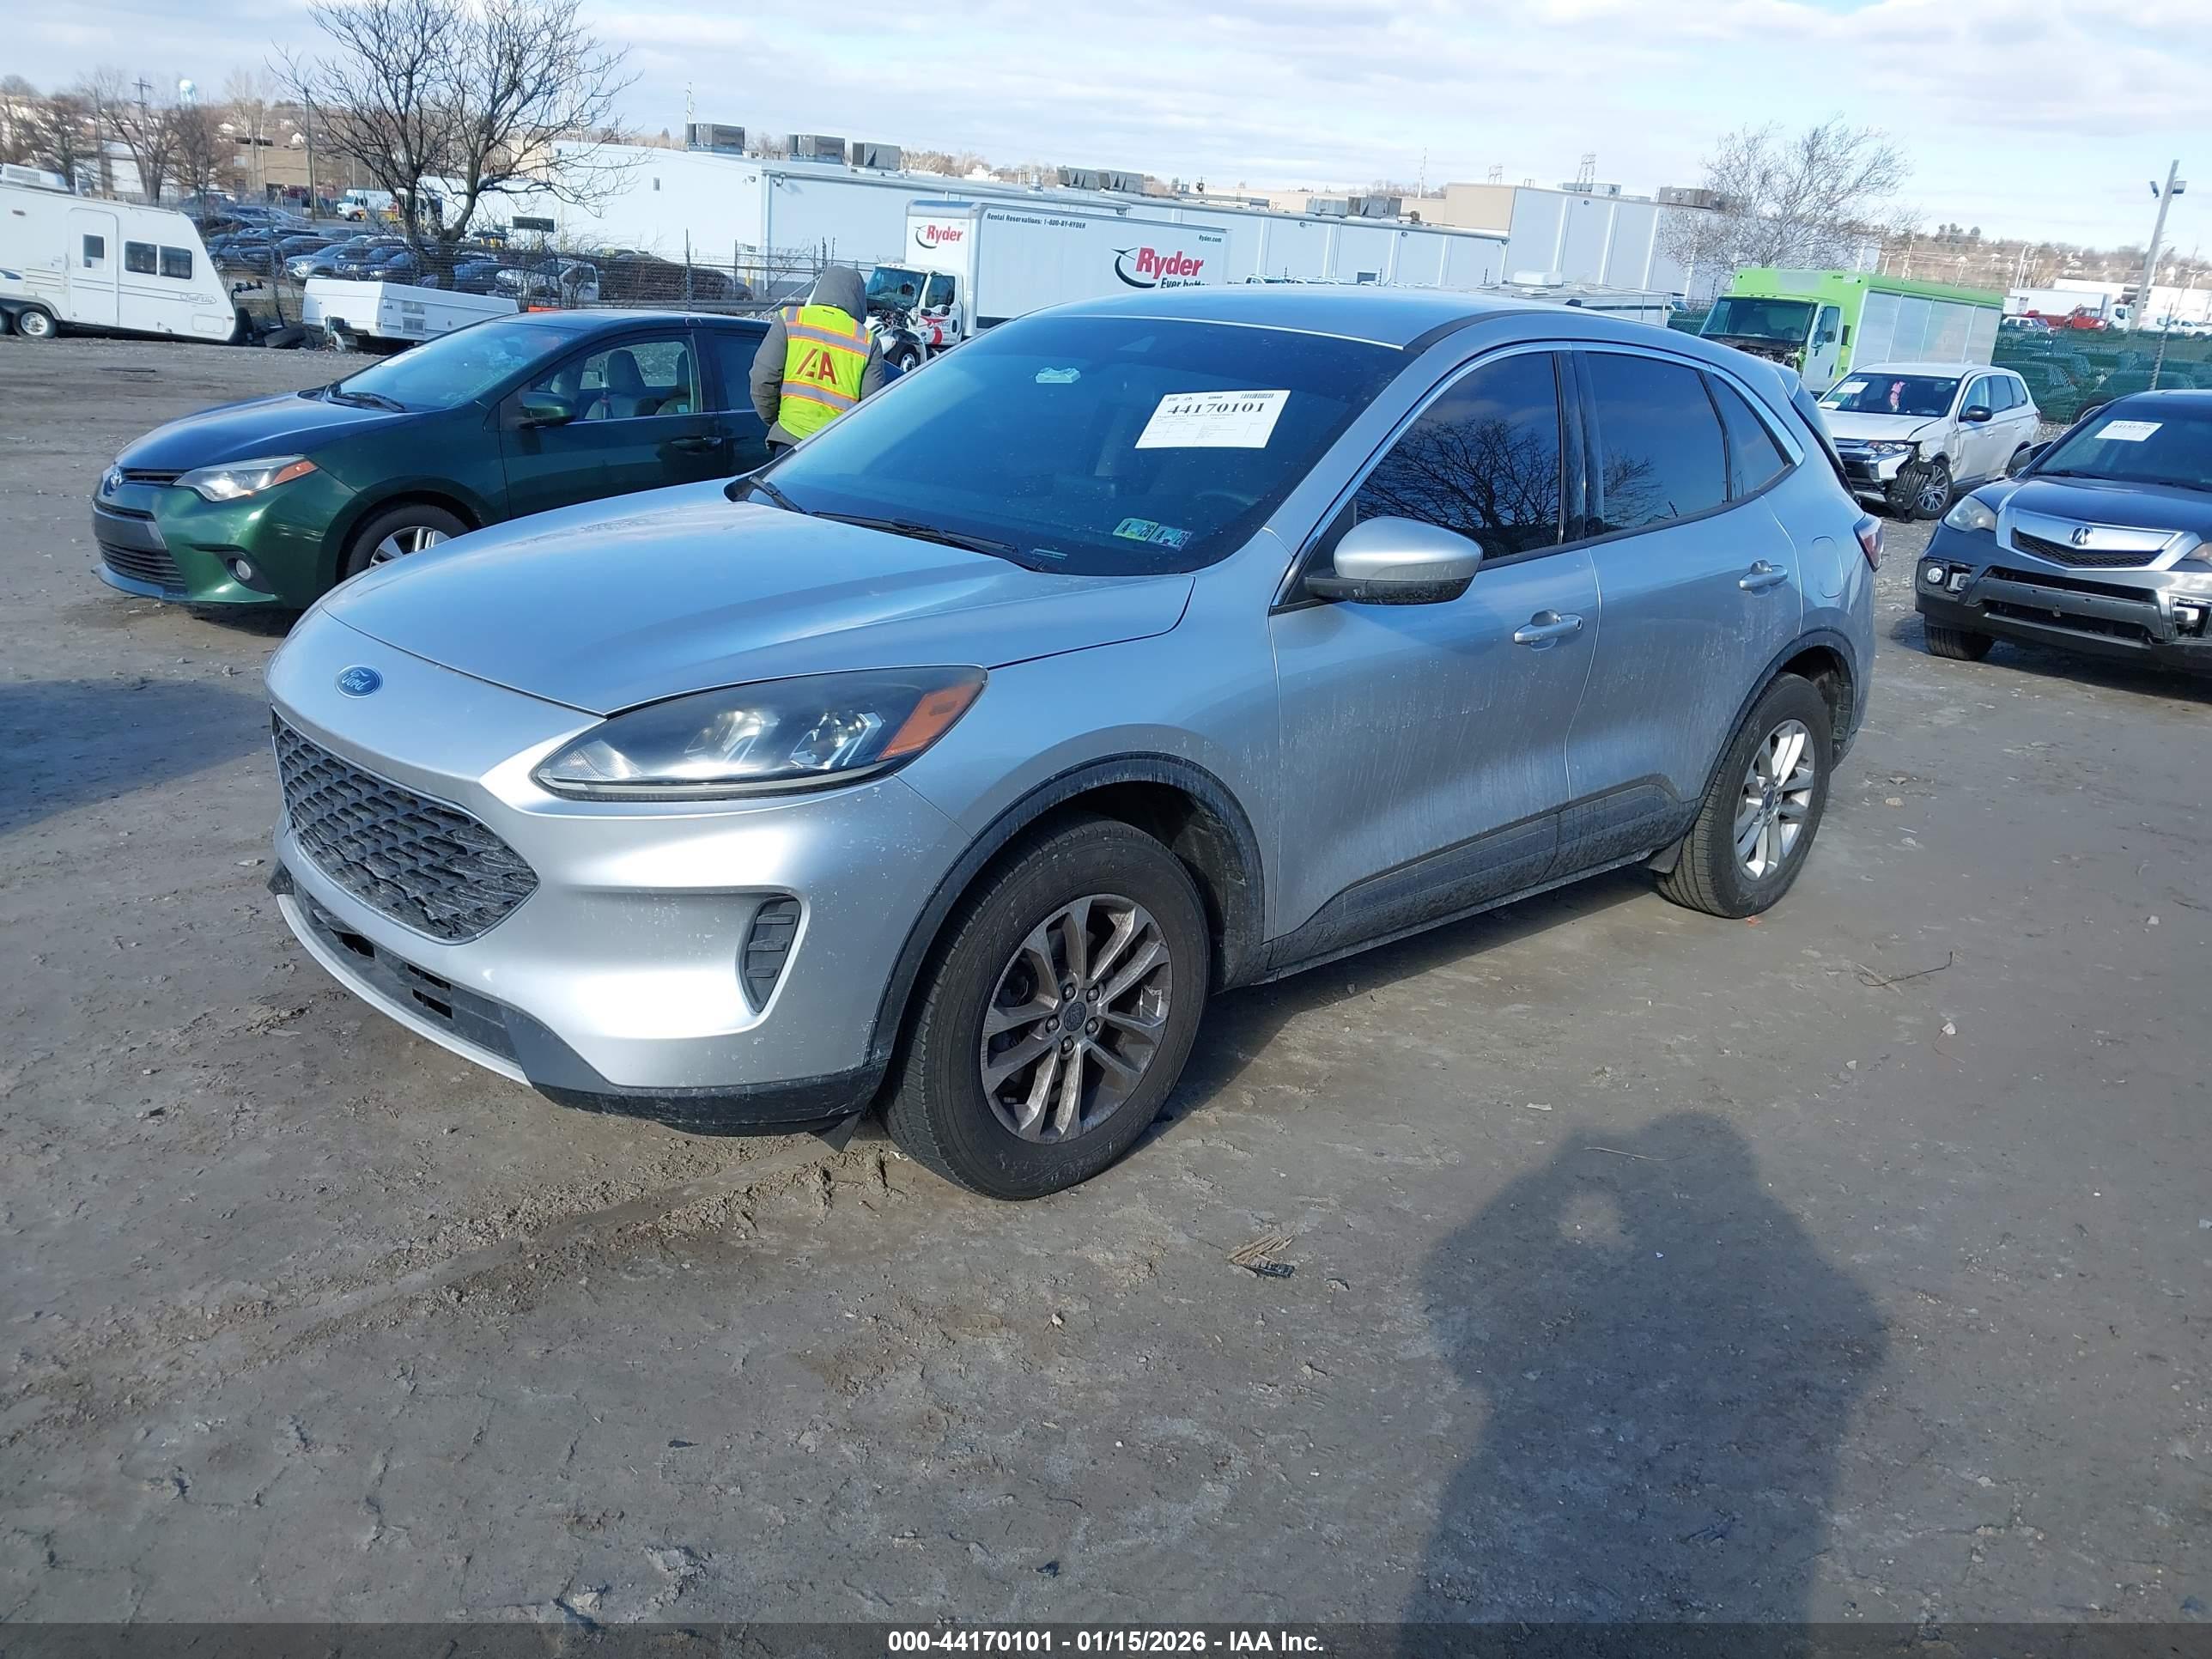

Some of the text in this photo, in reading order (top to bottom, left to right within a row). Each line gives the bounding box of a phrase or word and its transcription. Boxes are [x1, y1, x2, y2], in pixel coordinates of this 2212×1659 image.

[987, 212, 1005, 221] Rental
[1006, 215, 1042, 225] Reservations:
[926, 224, 963, 244] Ryder
[1198, 234, 1223, 244] Ryder.com
[1135, 246, 1205, 280] Ryder
[1167, 401, 1265, 415] 44170101
[1121, 522, 1132, 533] 4
[1155, 530, 1166, 541] 4
[342, 669, 370, 690] Ford
